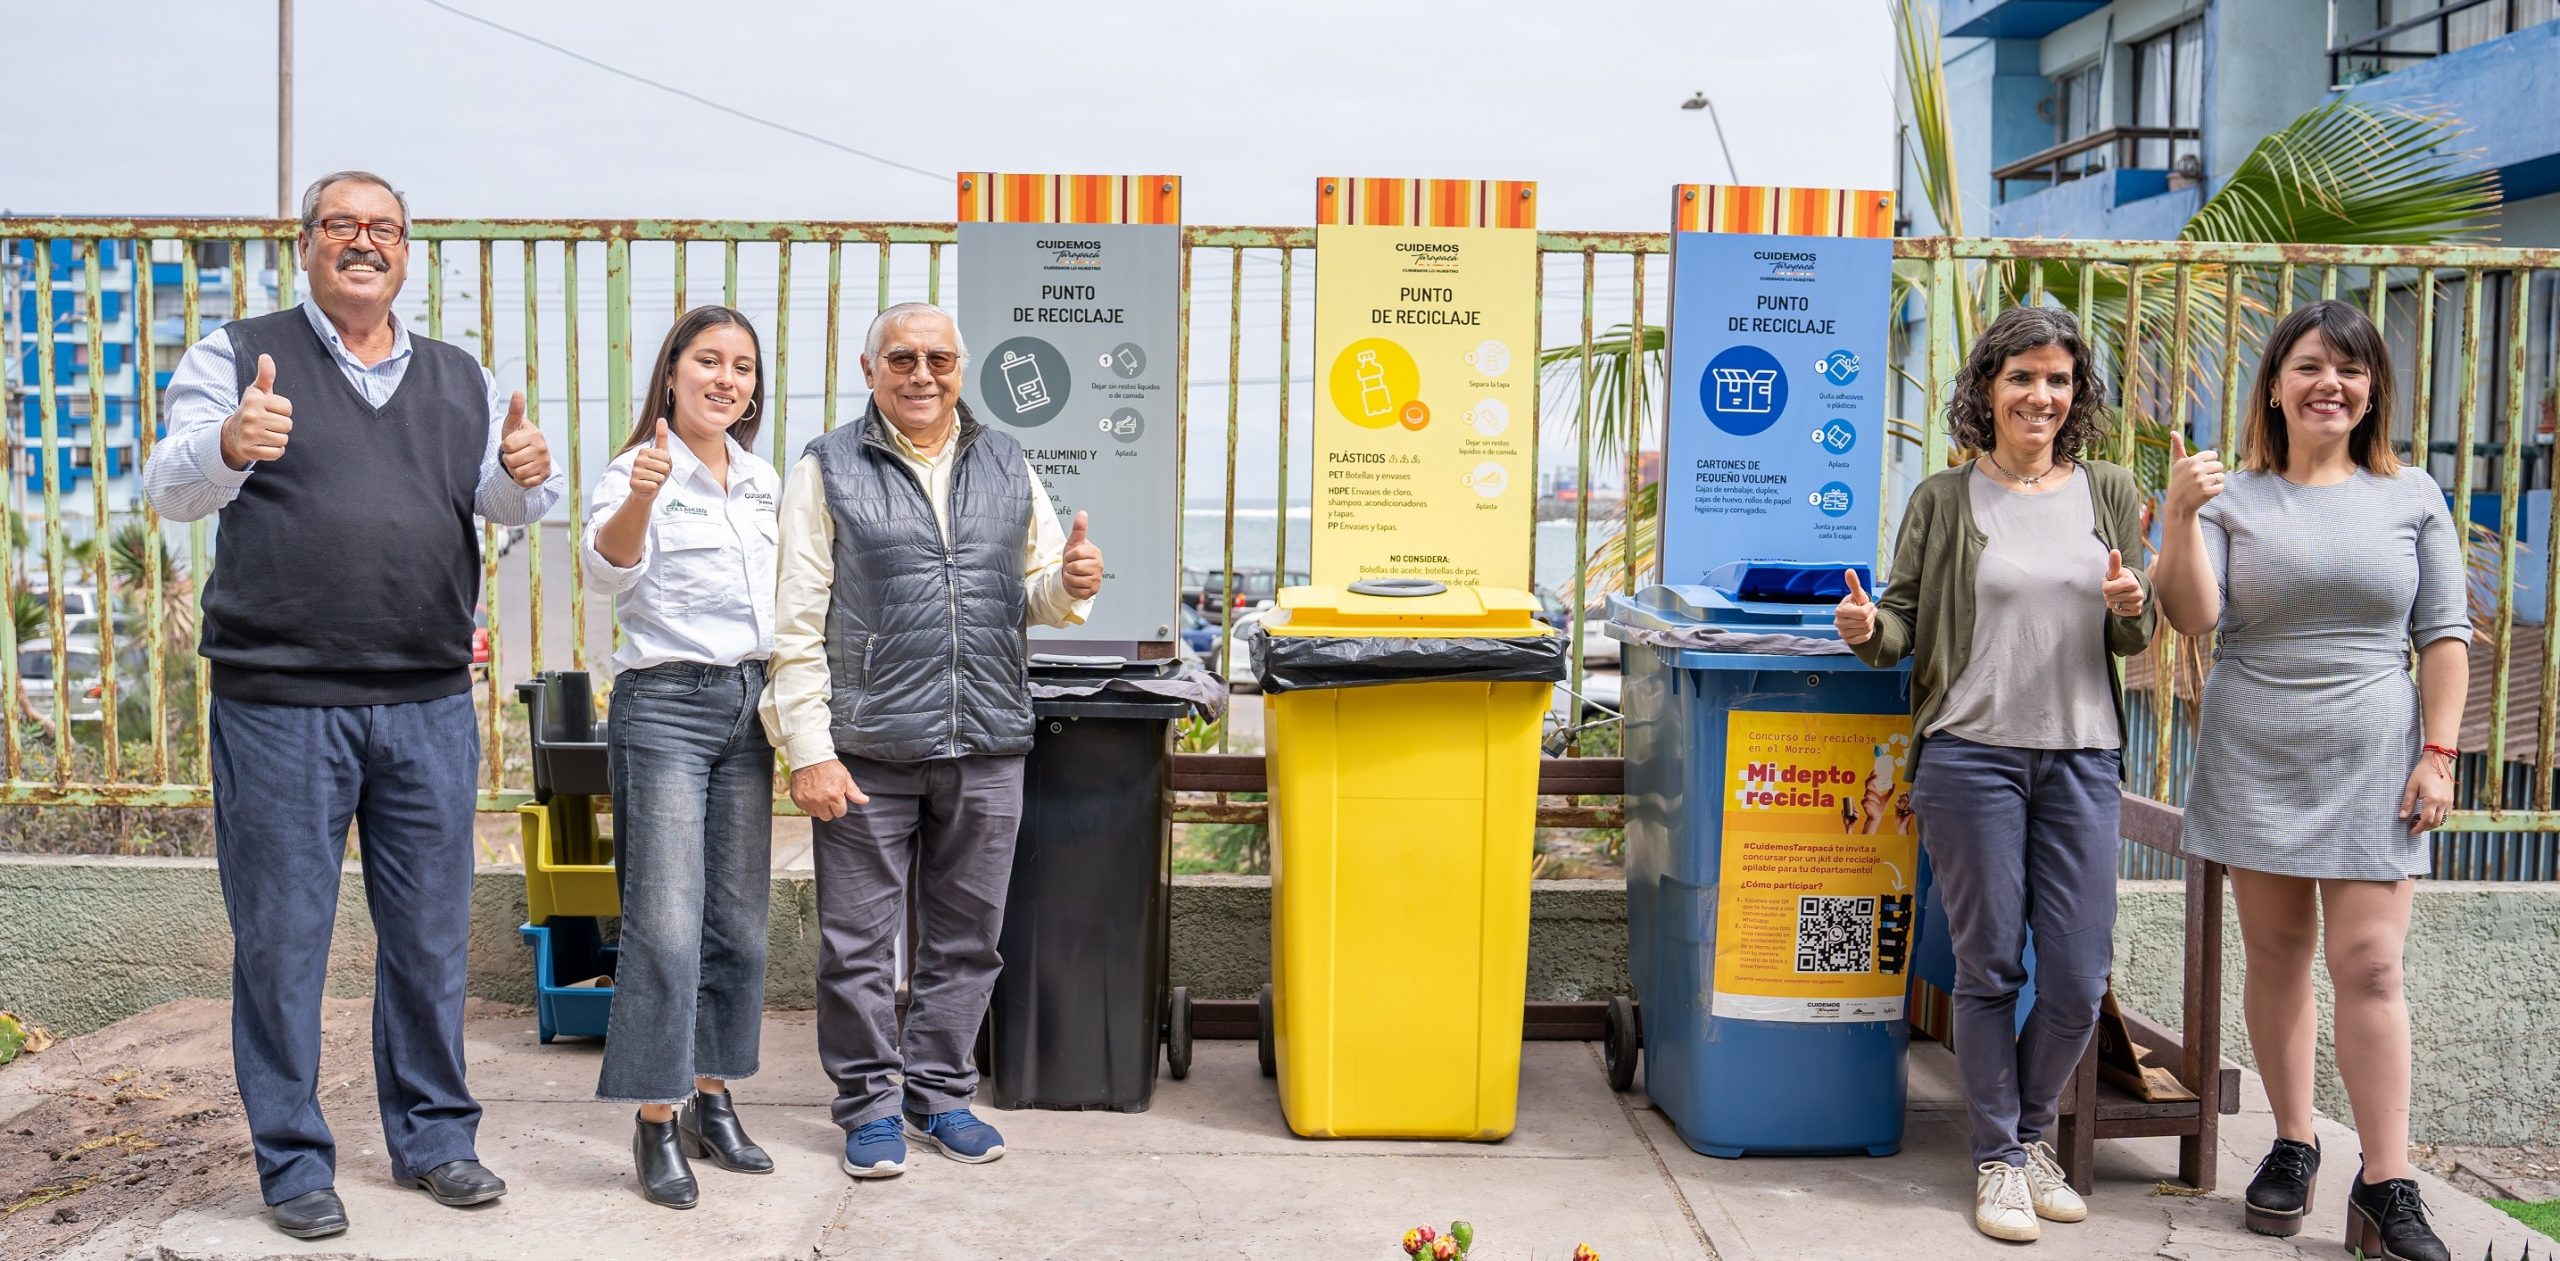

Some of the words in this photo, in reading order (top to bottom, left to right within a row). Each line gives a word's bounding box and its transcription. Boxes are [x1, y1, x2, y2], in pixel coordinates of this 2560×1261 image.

[1036, 241, 1101, 249] CUIDEMOS
[1396, 244, 1459, 252] CUIDEMOS
[1754, 252, 1816, 261] CUIDEMOS
[1042, 286, 1095, 300] PUNTO
[1400, 288, 1452, 302] PUNTO
[1758, 296, 1808, 311] PUNTO
[1014, 308, 1033, 322] DE
[1038, 308, 1123, 323] RECICLAJE
[1372, 310, 1392, 324] DE
[1396, 310, 1480, 325] RECICLAJE
[1729, 317, 1748, 332] DE
[1753, 318, 1835, 334] RECICLAJE
[1092, 383, 1107, 391] Dejar
[1138, 383, 1160, 391] líquidos
[1819, 392, 1834, 401] Quita
[1832, 401, 1856, 410] plásticos
[1466, 439, 1480, 447] Dejar
[1037, 450, 1087, 460] ALUMINIO
[1090, 450, 1097, 460] Y
[1330, 451, 1385, 463] PLÁSTICOS
[1046, 465, 1080, 474] METAL
[1697, 460, 1745, 470] CARTONES
[1748, 461, 1760, 470] DE
[1828, 461, 1849, 469] Aplasta
[1696, 472, 1739, 483] PEQUEÑO
[1742, 474, 1786, 484] VOLUMEN
[1393, 488, 1412, 497] cloro,
[1696, 485, 1712, 494] Cajas
[1724, 486, 1754, 495] embalaje,
[1756, 487, 1779, 496] duplex,
[1328, 499, 1363, 508] shampoo,
[1365, 500, 1427, 508] acondicionadores
[1695, 496, 1711, 505] cajas
[1722, 496, 1743, 504] huevo,
[1774, 498, 1791, 507] papel
[1334, 510, 1354, 518] tapas.
[1695, 506, 1723, 514] higiénico
[1730, 507, 1767, 515] corrugados.
[1377, 524, 1398, 532] tapas.
[1749, 732, 1798, 742] Concurso
[1805, 733, 1817, 742] de
[1824, 734, 1877, 744] reciclaje
[1767, 744, 1778, 752] el
[1786, 745, 1821, 754] Morro:
[1748, 764, 1775, 782] Mi
[1781, 765, 1855, 788] depto
[1746, 788, 1834, 807] recicla
[1744, 843, 1833, 853] #CuidemosTarapacá
[1845, 855, 1880, 864] reciclaje
[1742, 865, 1776, 873] apilable
[1741, 880, 1772, 889] ¿Cómo
[1774, 882, 1823, 891] participar?
